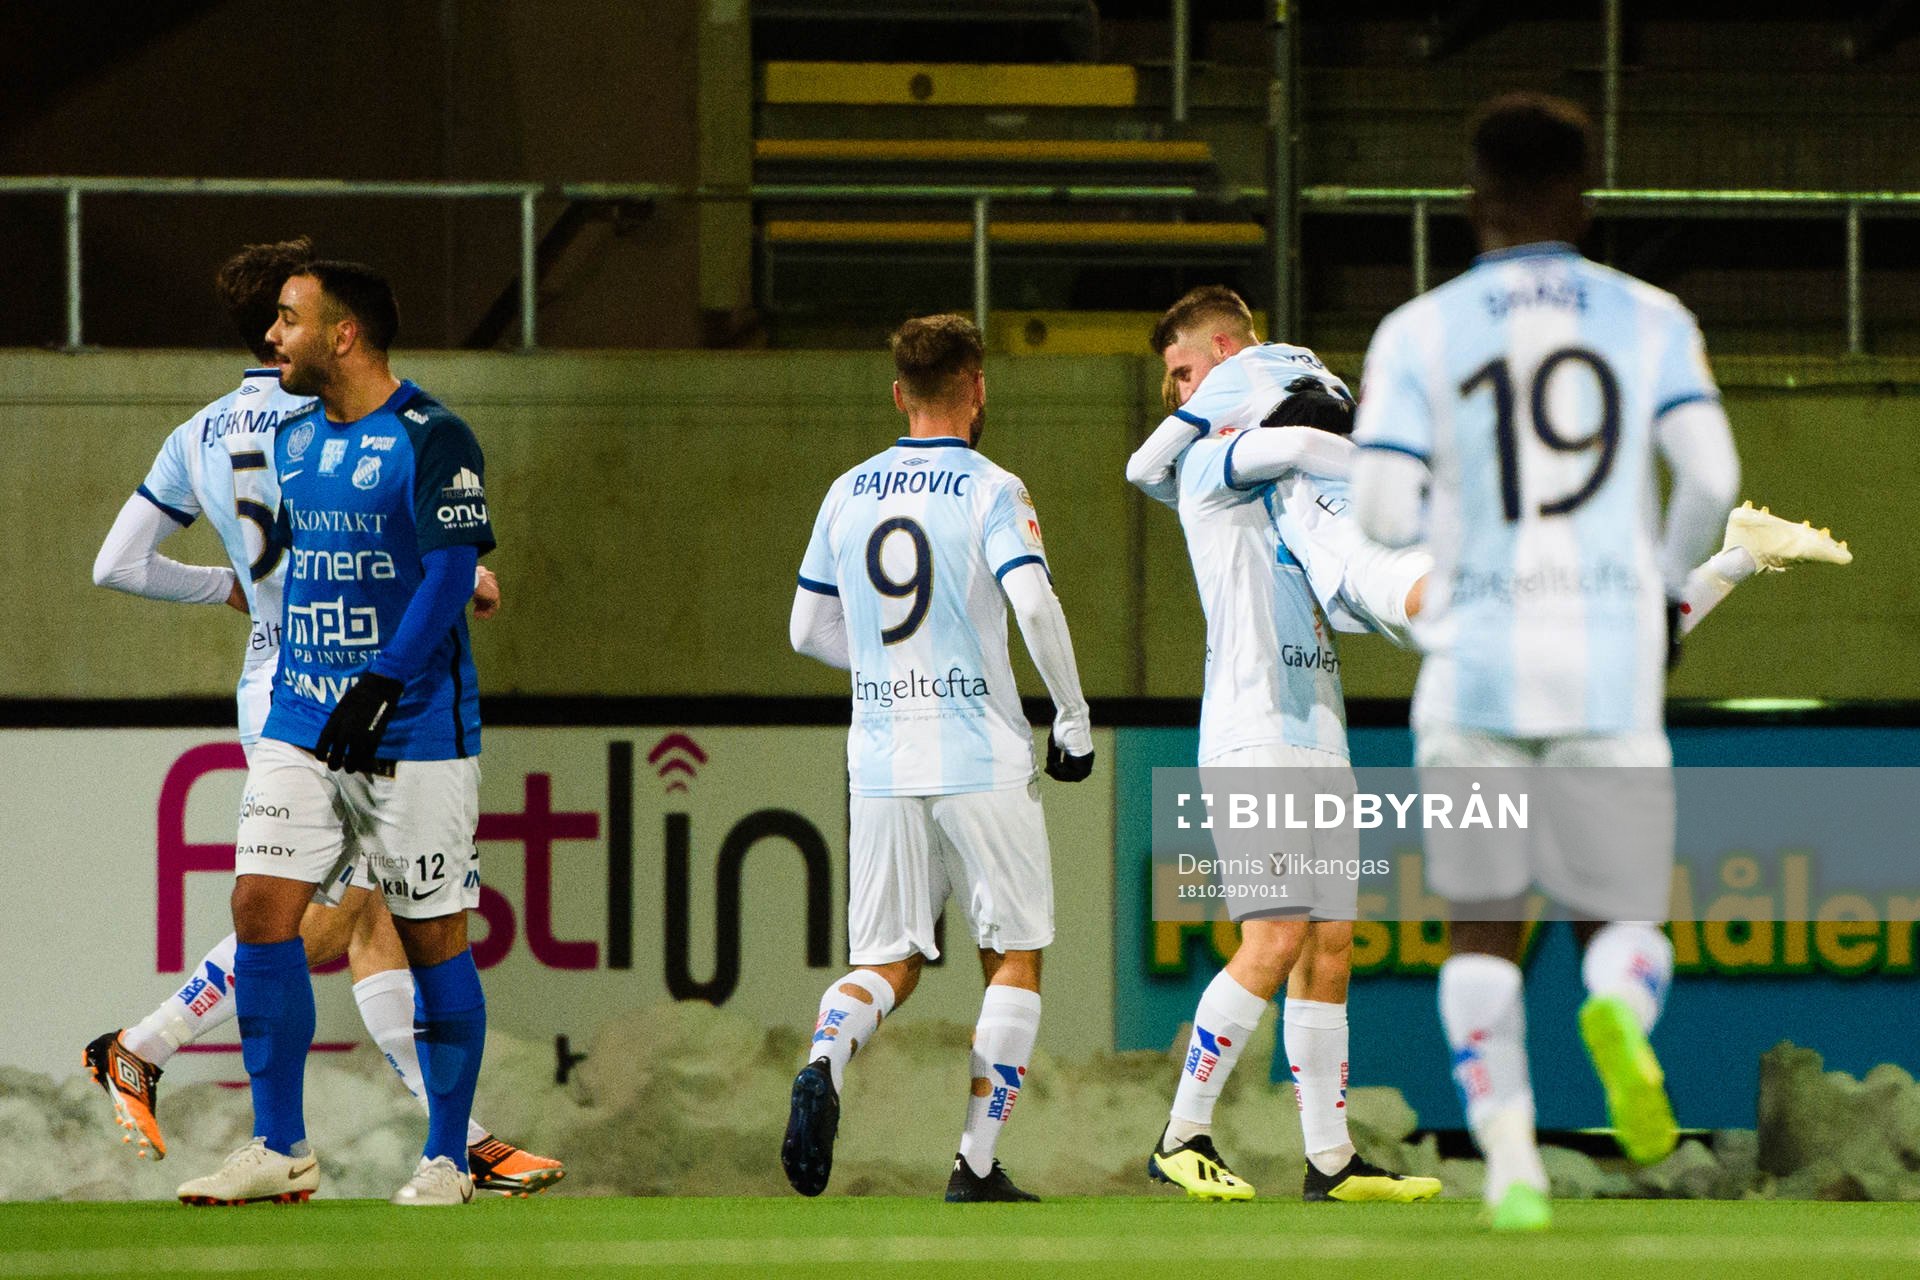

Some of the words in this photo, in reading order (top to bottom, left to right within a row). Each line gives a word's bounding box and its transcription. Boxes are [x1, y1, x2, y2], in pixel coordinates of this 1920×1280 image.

[1459, 347, 1622, 522] 19
[853, 471, 970, 500] BAJROVIC
[229, 450, 291, 585] 5
[865, 515, 935, 647] 9
[856, 667, 990, 708] Engeltofta
[416, 853, 445, 882] 12
[1196, 1052, 1218, 1083] INTER
